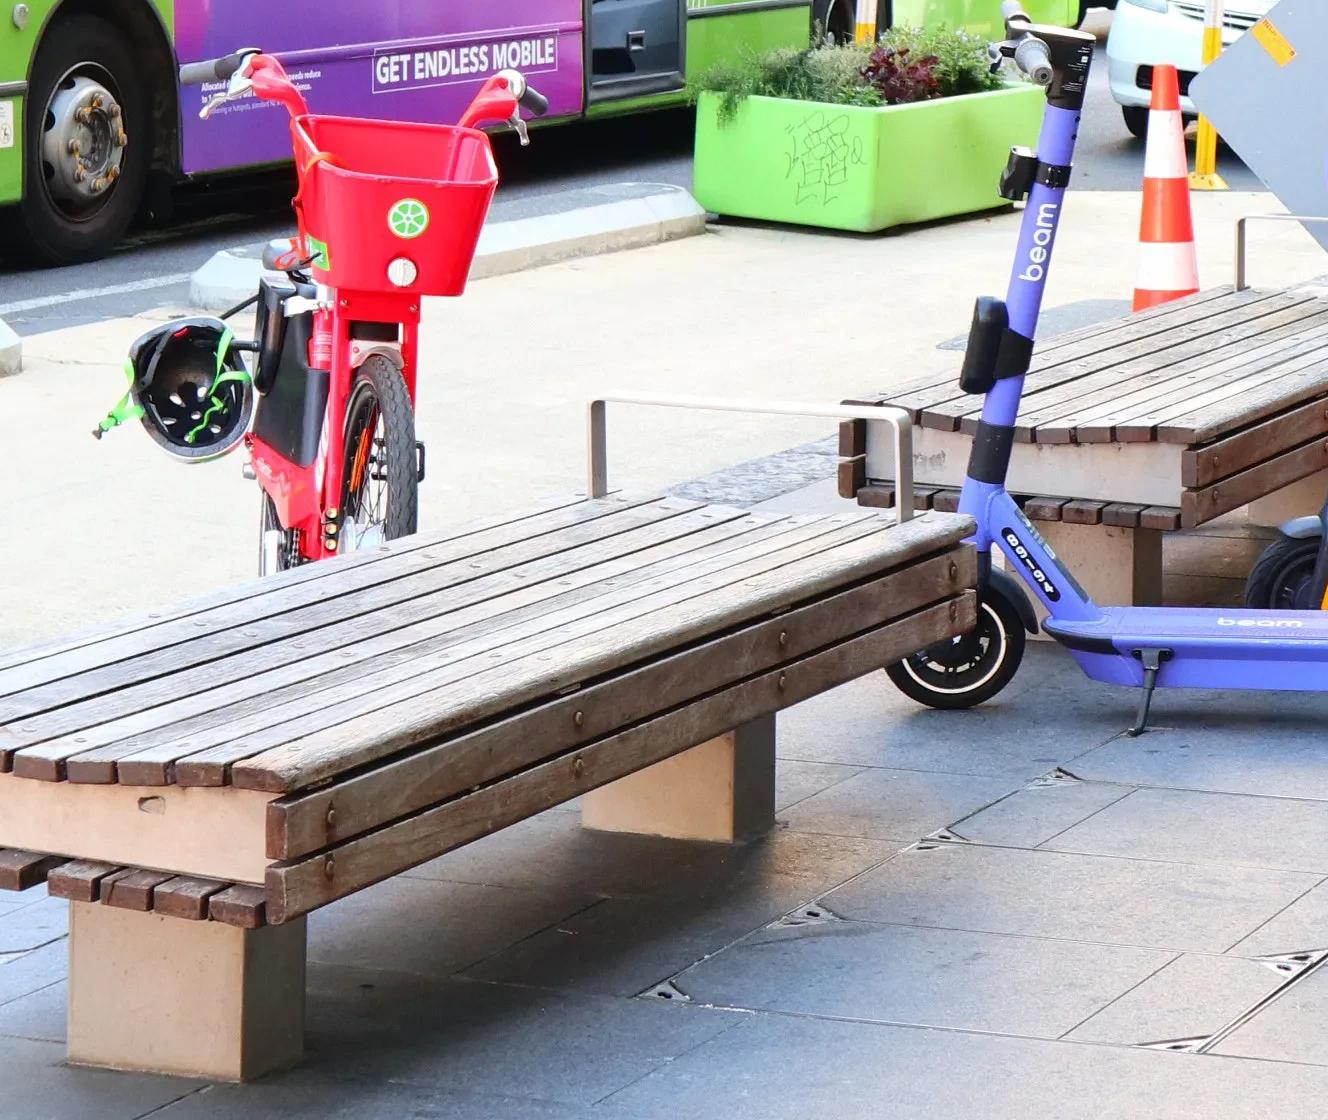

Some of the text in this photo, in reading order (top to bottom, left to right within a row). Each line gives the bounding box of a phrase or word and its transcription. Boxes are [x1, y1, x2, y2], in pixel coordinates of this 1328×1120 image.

[376, 37, 555, 85] GET ENDLESS MOBILE
[1017, 203, 1058, 282] beam
[1006, 533, 1055, 593] 89194
[1216, 616, 1303, 628] beam
